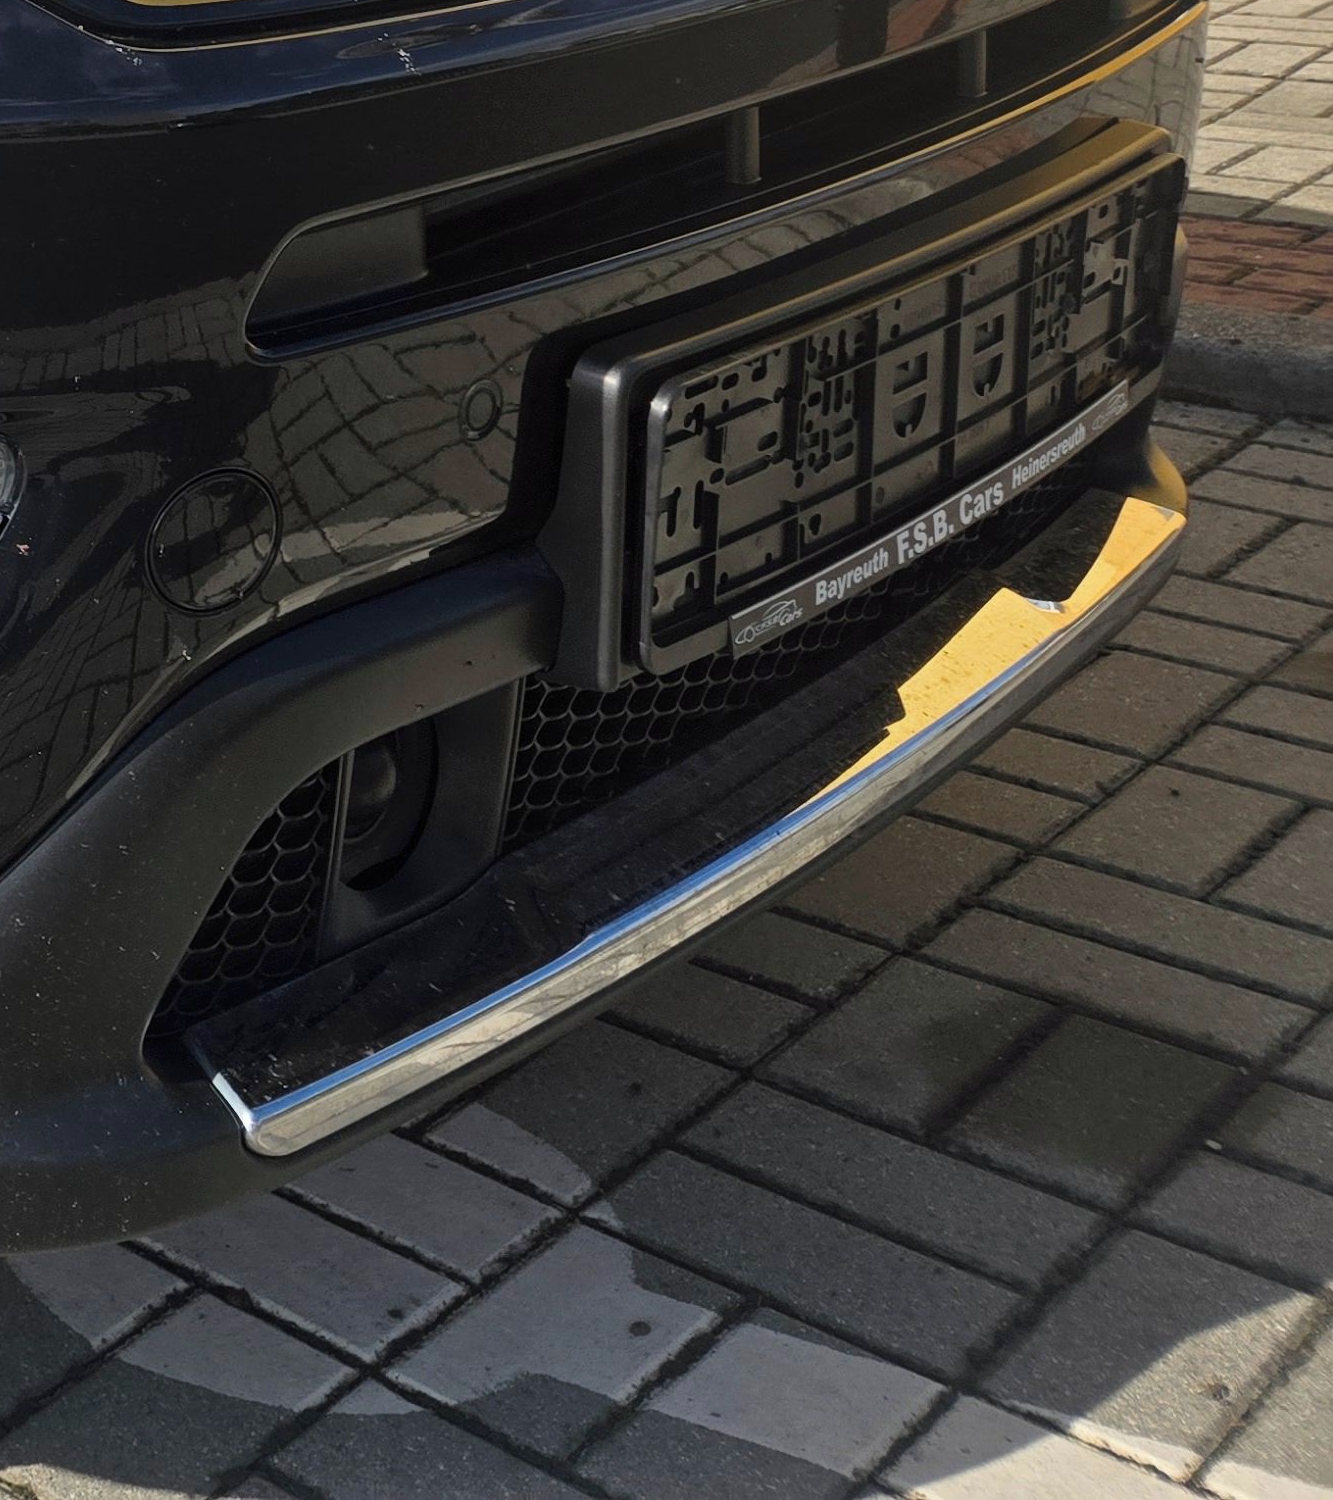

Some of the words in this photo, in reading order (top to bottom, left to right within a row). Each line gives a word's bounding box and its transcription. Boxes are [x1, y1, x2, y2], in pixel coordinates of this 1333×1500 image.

[815, 547, 889, 606] Bayreuth
[896, 509, 955, 565] F.S.B.
[959, 481, 1004, 525] Cars
[1011, 422, 1087, 490] Heinersreuth
